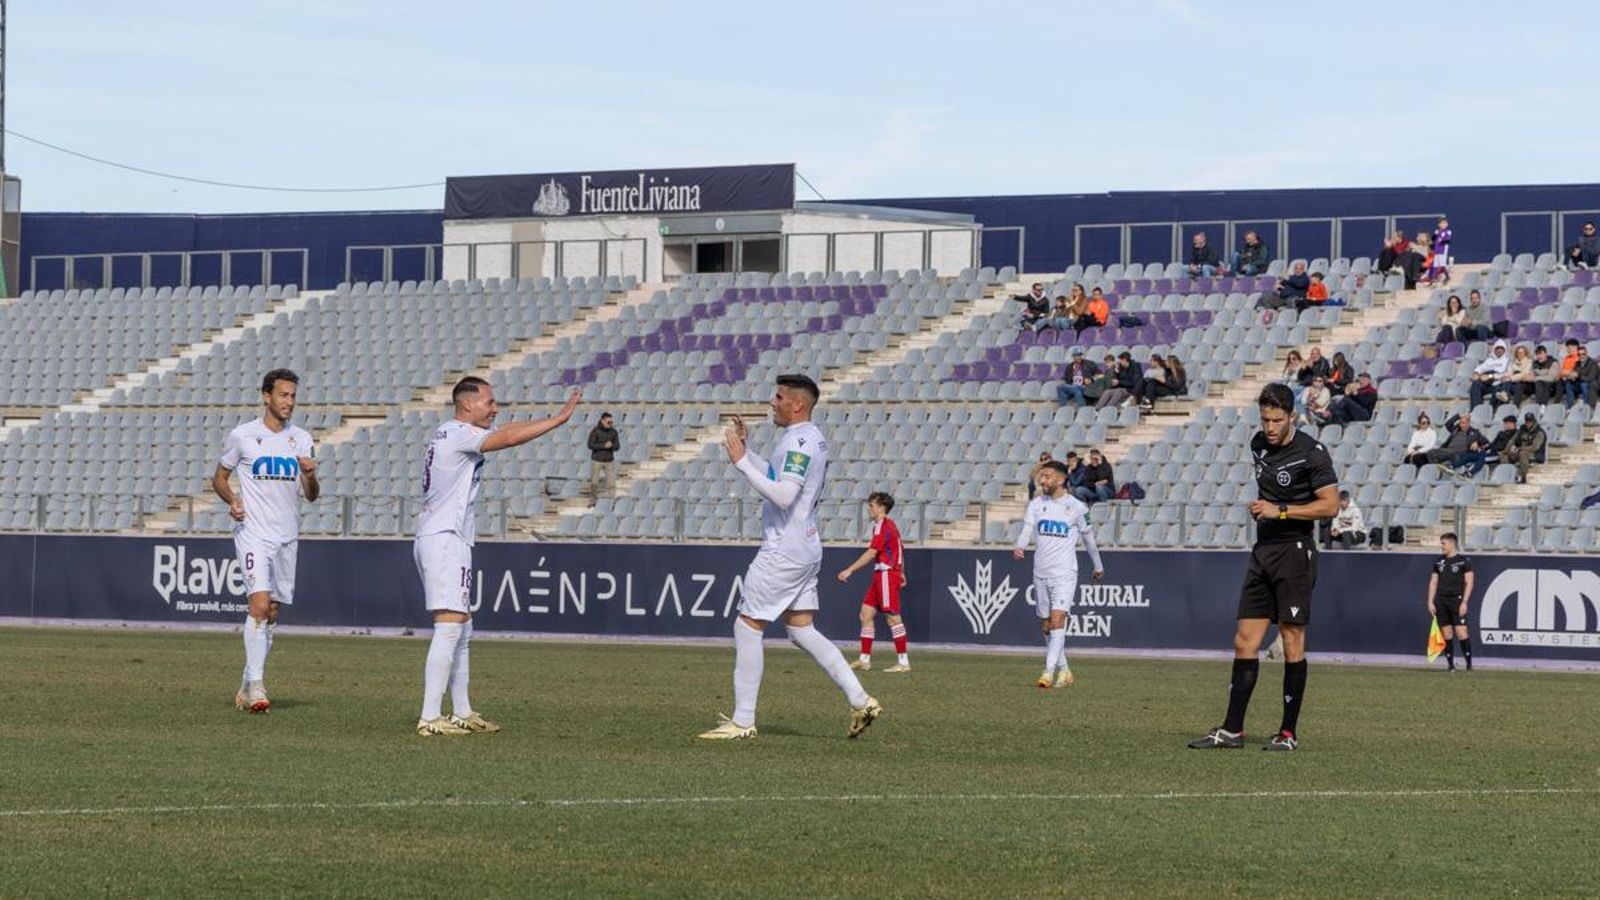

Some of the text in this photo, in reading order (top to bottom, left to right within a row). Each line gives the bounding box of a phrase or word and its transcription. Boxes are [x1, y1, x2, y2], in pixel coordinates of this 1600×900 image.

[581, 173, 700, 213] FuenteLiviana
[245, 551, 254, 570] 6
[460, 566, 473, 589] 18
[1079, 584, 1150, 607] RURAL
